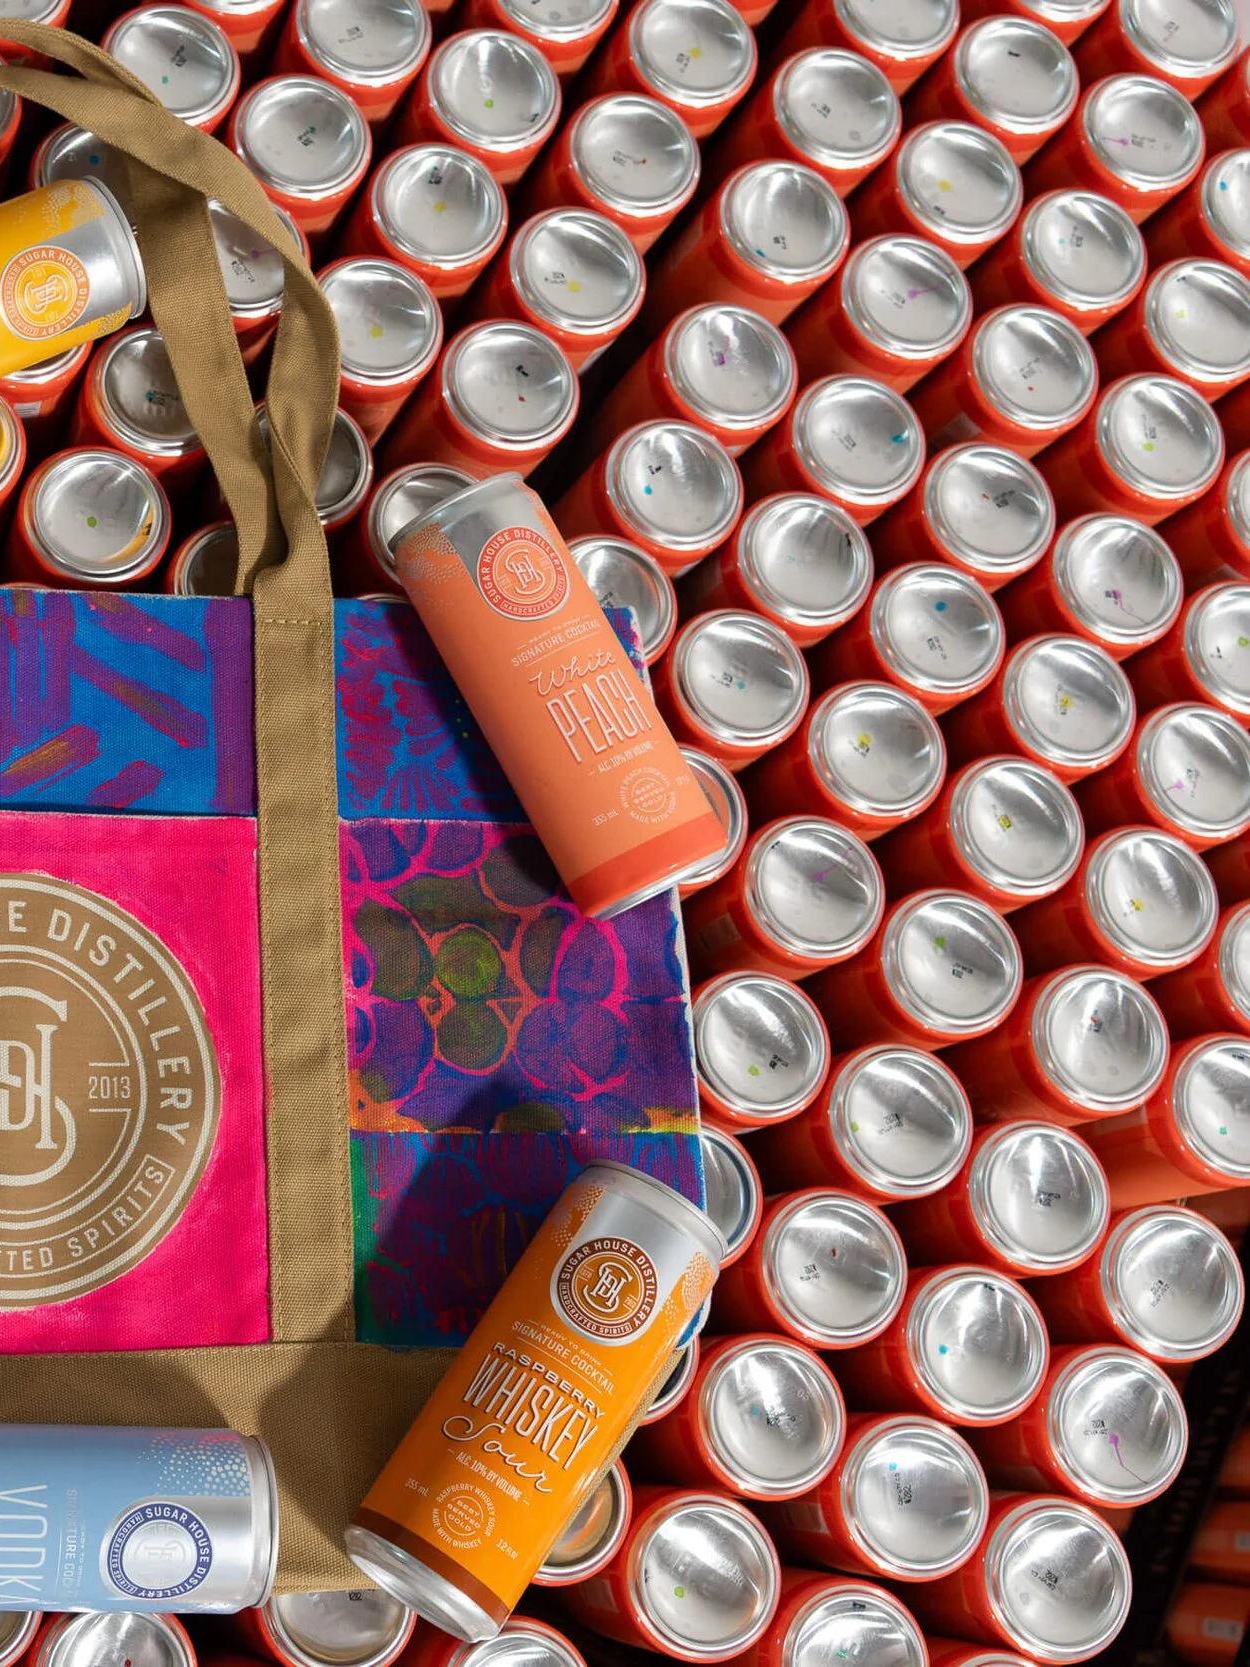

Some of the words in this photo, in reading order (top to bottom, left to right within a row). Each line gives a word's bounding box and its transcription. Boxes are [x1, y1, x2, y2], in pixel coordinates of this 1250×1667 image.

[19, 250, 55, 266] SUGAR
[58, 252, 87, 283] HOUSE
[42, 287, 87, 336] DISTILLERY
[483, 532, 510, 562] HOUSE
[513, 529, 562, 572] DISTILLERY
[482, 567, 501, 602] SUGAR
[511, 634, 566, 666] SIGNATURE
[530, 650, 615, 695] White
[546, 668, 652, 762] PEACH
[47, 909, 193, 1146] DISTILLERY
[88, 1076, 131, 1099] 2013
[66, 1165, 164, 1258] SPIRITS
[561, 1246, 591, 1280] SUGAR
[594, 1240, 637, 1257] HOUSE
[634, 1256, 656, 1327] DISTILLERY
[561, 1283, 597, 1331] HANDCRAFTED
[599, 1323, 631, 1334] SPIRITS
[511, 1321, 571, 1359] SIGNATURE
[571, 1354, 615, 1395] COCKTAIL
[492, 1342, 606, 1419] RASPBERRY
[463, 1353, 598, 1470] WHISKEY
[443, 1415, 553, 1493] Sour
[436, 1483, 473, 1503] RASPBERRY
[474, 1485, 496, 1515] WHISKEY
[470, 1460, 488, 1477] 10%
[486, 1470, 499, 1483] BY
[496, 1475, 523, 1502] VOLUME
[146, 1507, 187, 1523] SUGAR
[448, 1514, 471, 1532] COLD
[189, 1521, 209, 1562] HOUSE
[496, 1539, 508, 1551] 12
[138, 1567, 206, 1597] DISTILLERY
